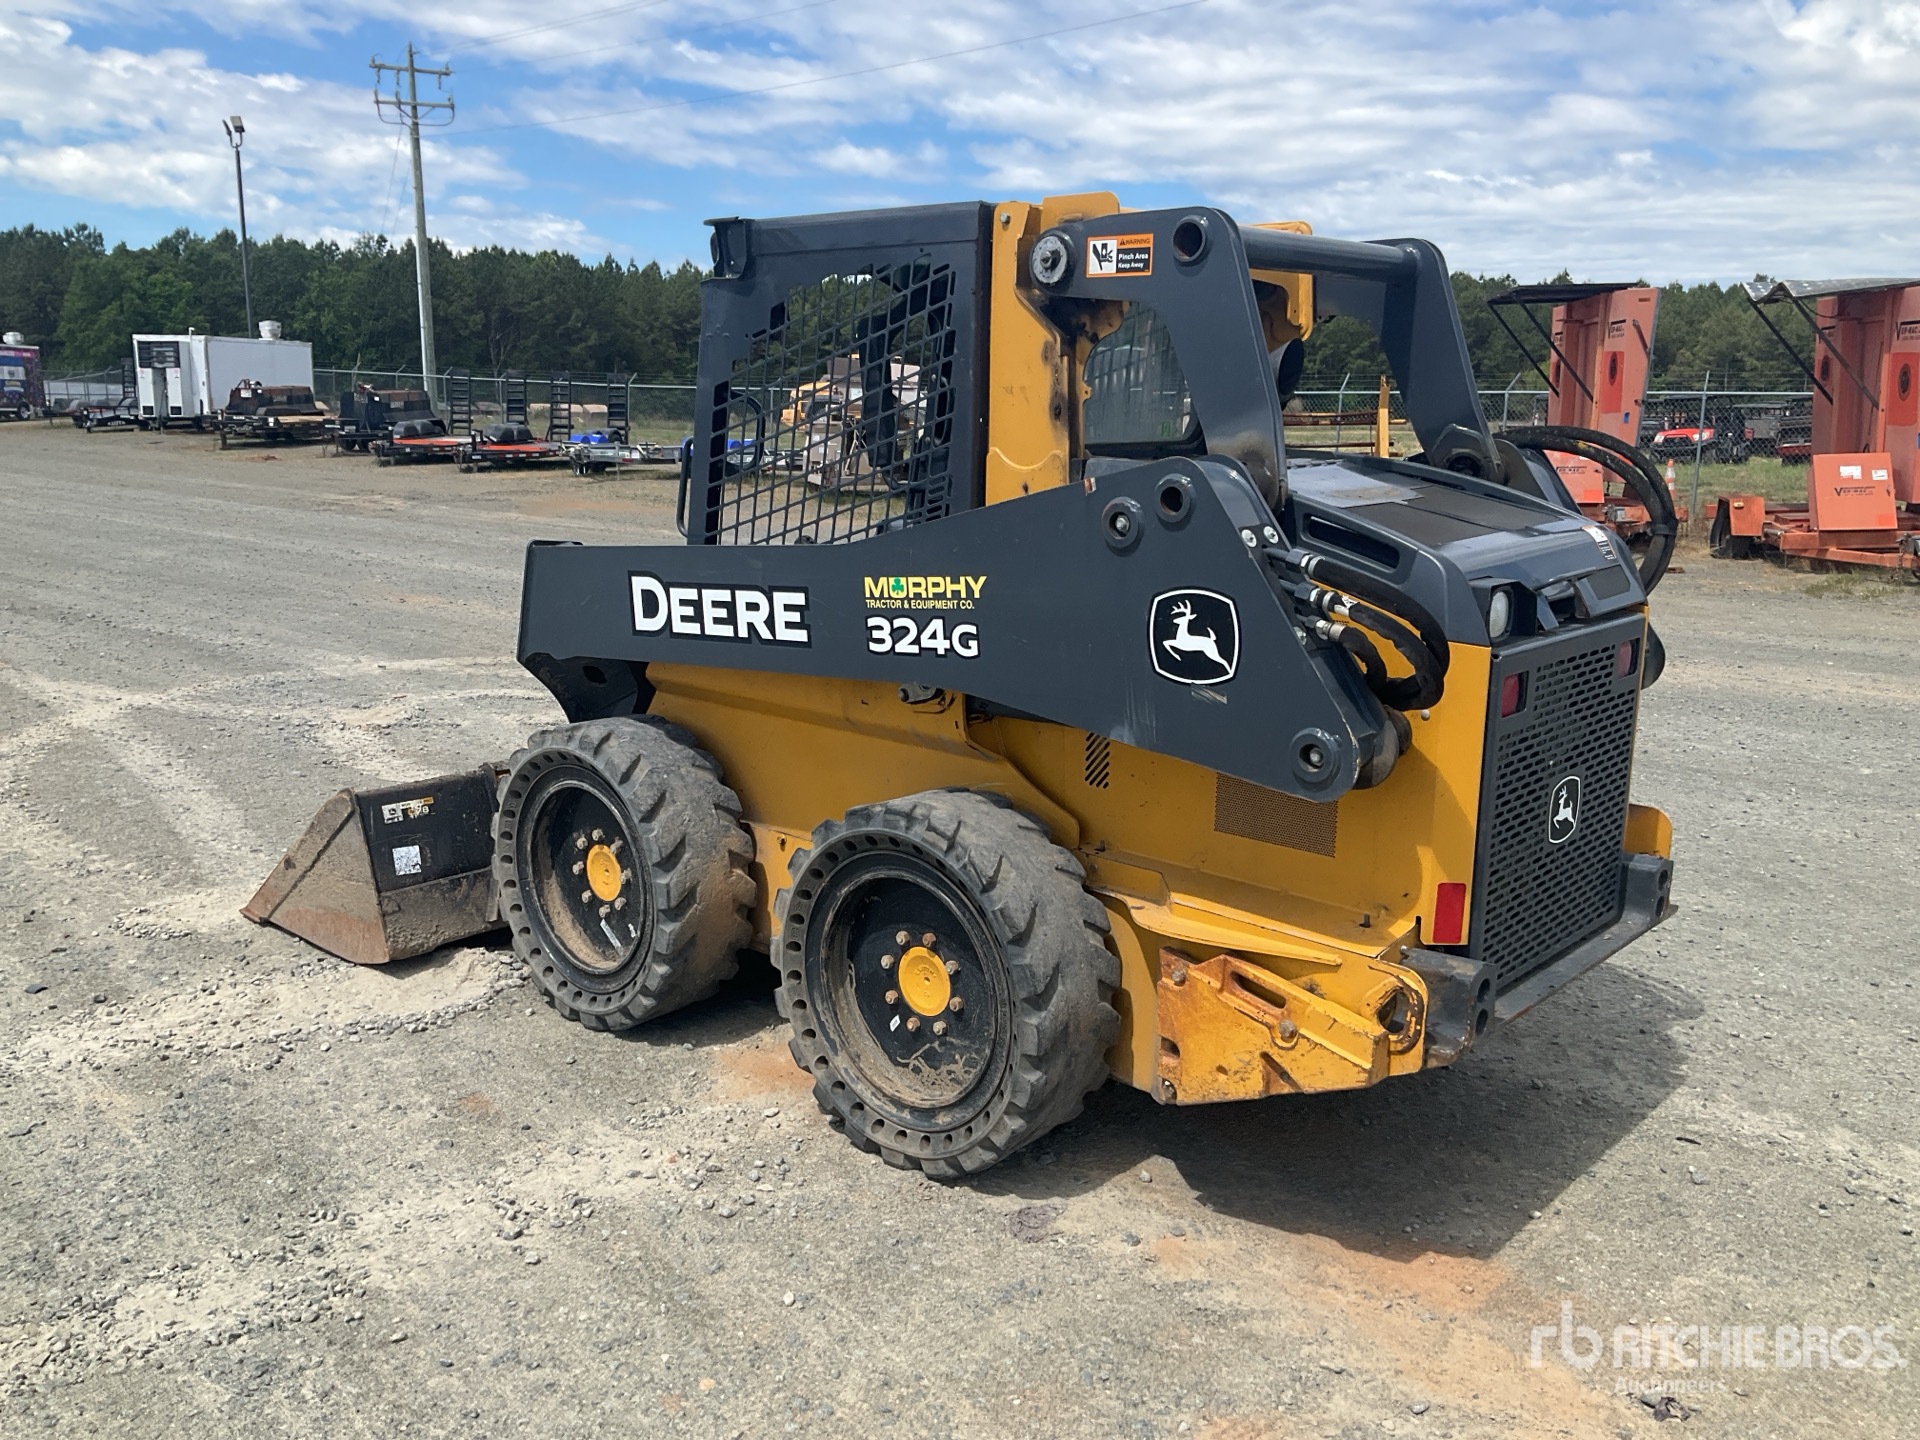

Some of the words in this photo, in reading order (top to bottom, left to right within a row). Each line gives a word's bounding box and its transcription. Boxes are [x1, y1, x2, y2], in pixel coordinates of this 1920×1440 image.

[1135, 252, 1149, 260] Area
[1130, 261, 1144, 269] Away
[864, 576, 987, 599] MURPHY
[631, 575, 809, 643] DEERE
[865, 599, 902, 609] TRACTOR
[903, 599, 910, 609] &
[911, 600, 958, 610] EQUIPMENT
[959, 600, 975, 610] CO.
[867, 616, 979, 658] 324G
